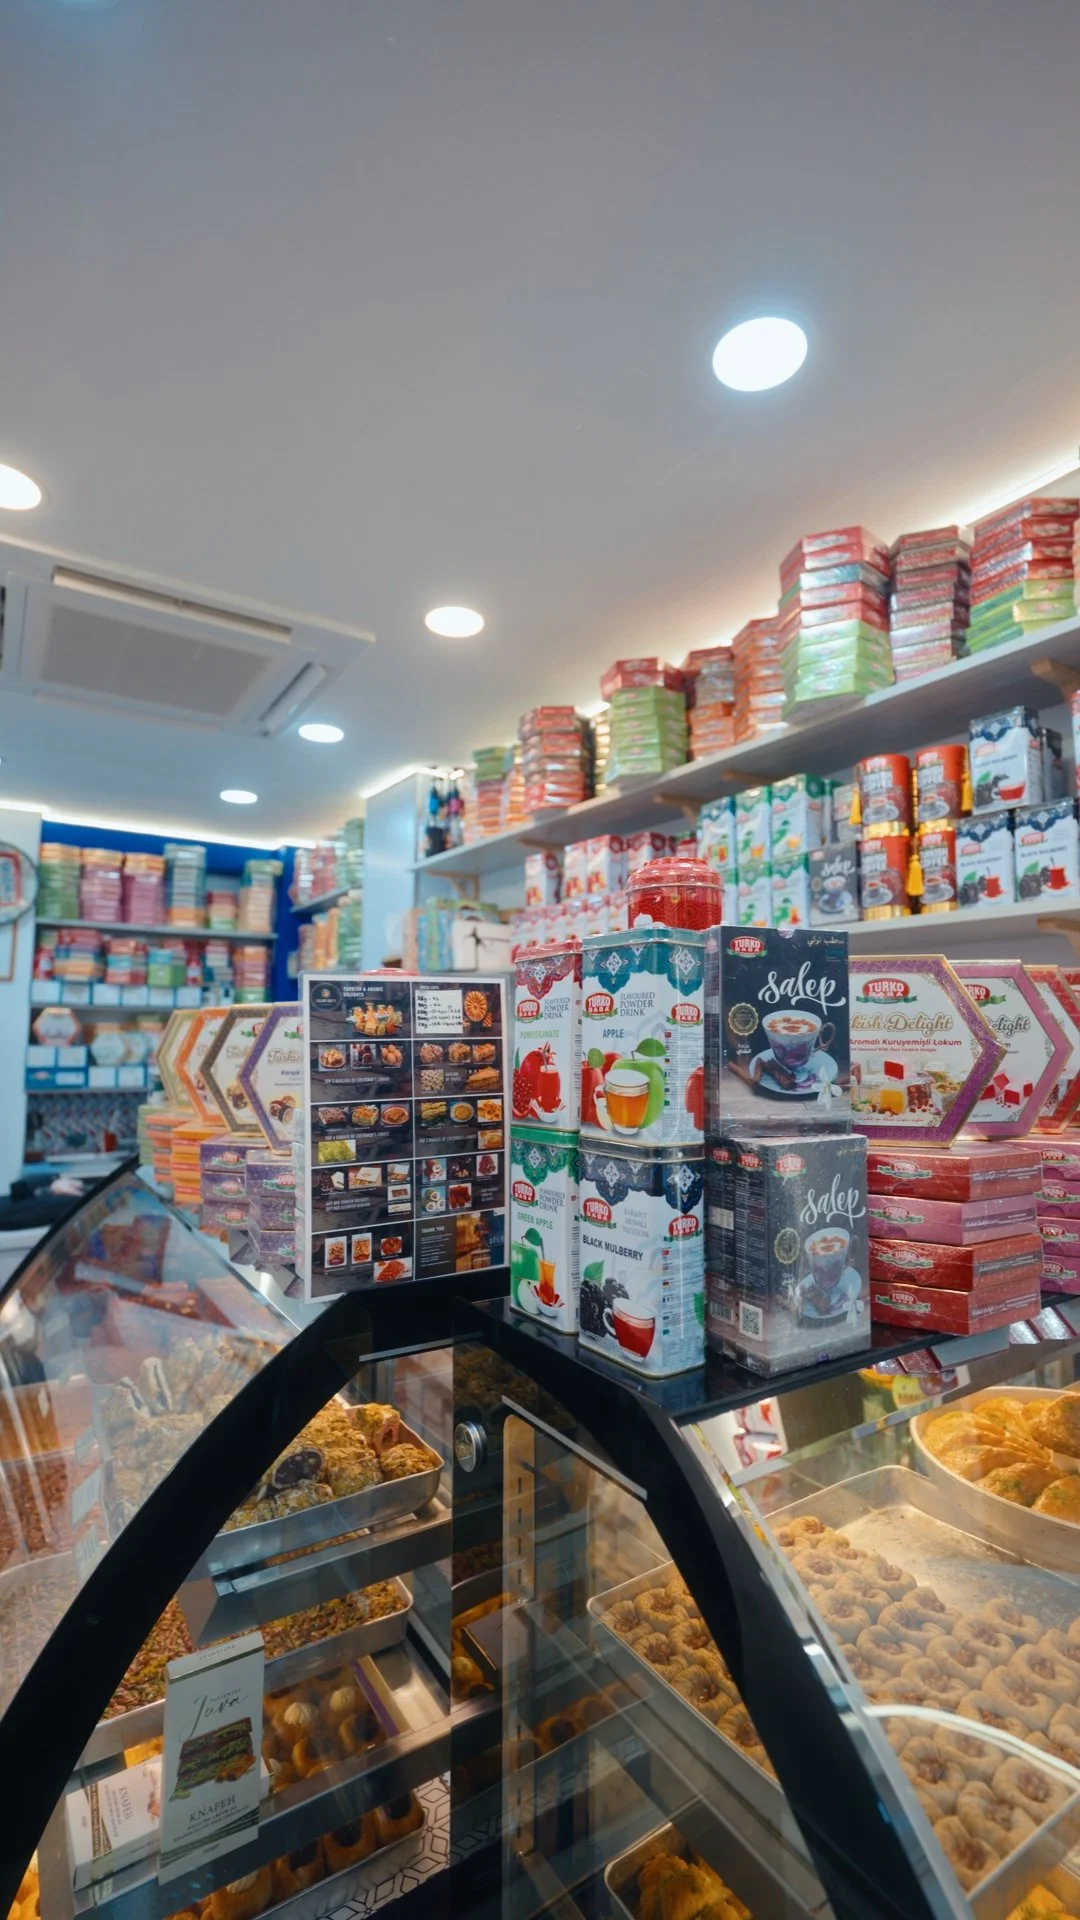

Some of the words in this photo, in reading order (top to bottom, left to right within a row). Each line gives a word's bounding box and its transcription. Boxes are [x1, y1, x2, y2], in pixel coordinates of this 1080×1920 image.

[735, 940, 761, 949] TURKO
[867, 982, 905, 992] TURKO
[587, 994, 612, 1007] TURKO
[620, 991, 656, 1000] FLAVOURED
[519, 1001, 538, 1012] TURKO
[544, 1003, 570, 1012] POWDER
[620, 1000, 654, 1009] POWDER
[544, 1012, 564, 1020] DRINK
[620, 1008, 646, 1017] DRINK
[675, 1006, 699, 1017] TURKO
[886, 1011, 953, 1037] Delight
[991, 1015, 1030, 1037] elight
[603, 1028, 625, 1038] APPLE
[933, 1038, 962, 1046] Lokum
[514, 1183, 533, 1197] TURKO
[586, 1201, 609, 1216] TURKO
[535, 1216, 554, 1231] APPLE
[672, 1216, 697, 1231] TURKO
[582, 1235, 604, 1251] BLACK
[604, 1241, 645, 1262] MULBERRY
[119, 1786, 134, 1821] KNAFEH
[189, 1795, 236, 1823] KNAFEH
